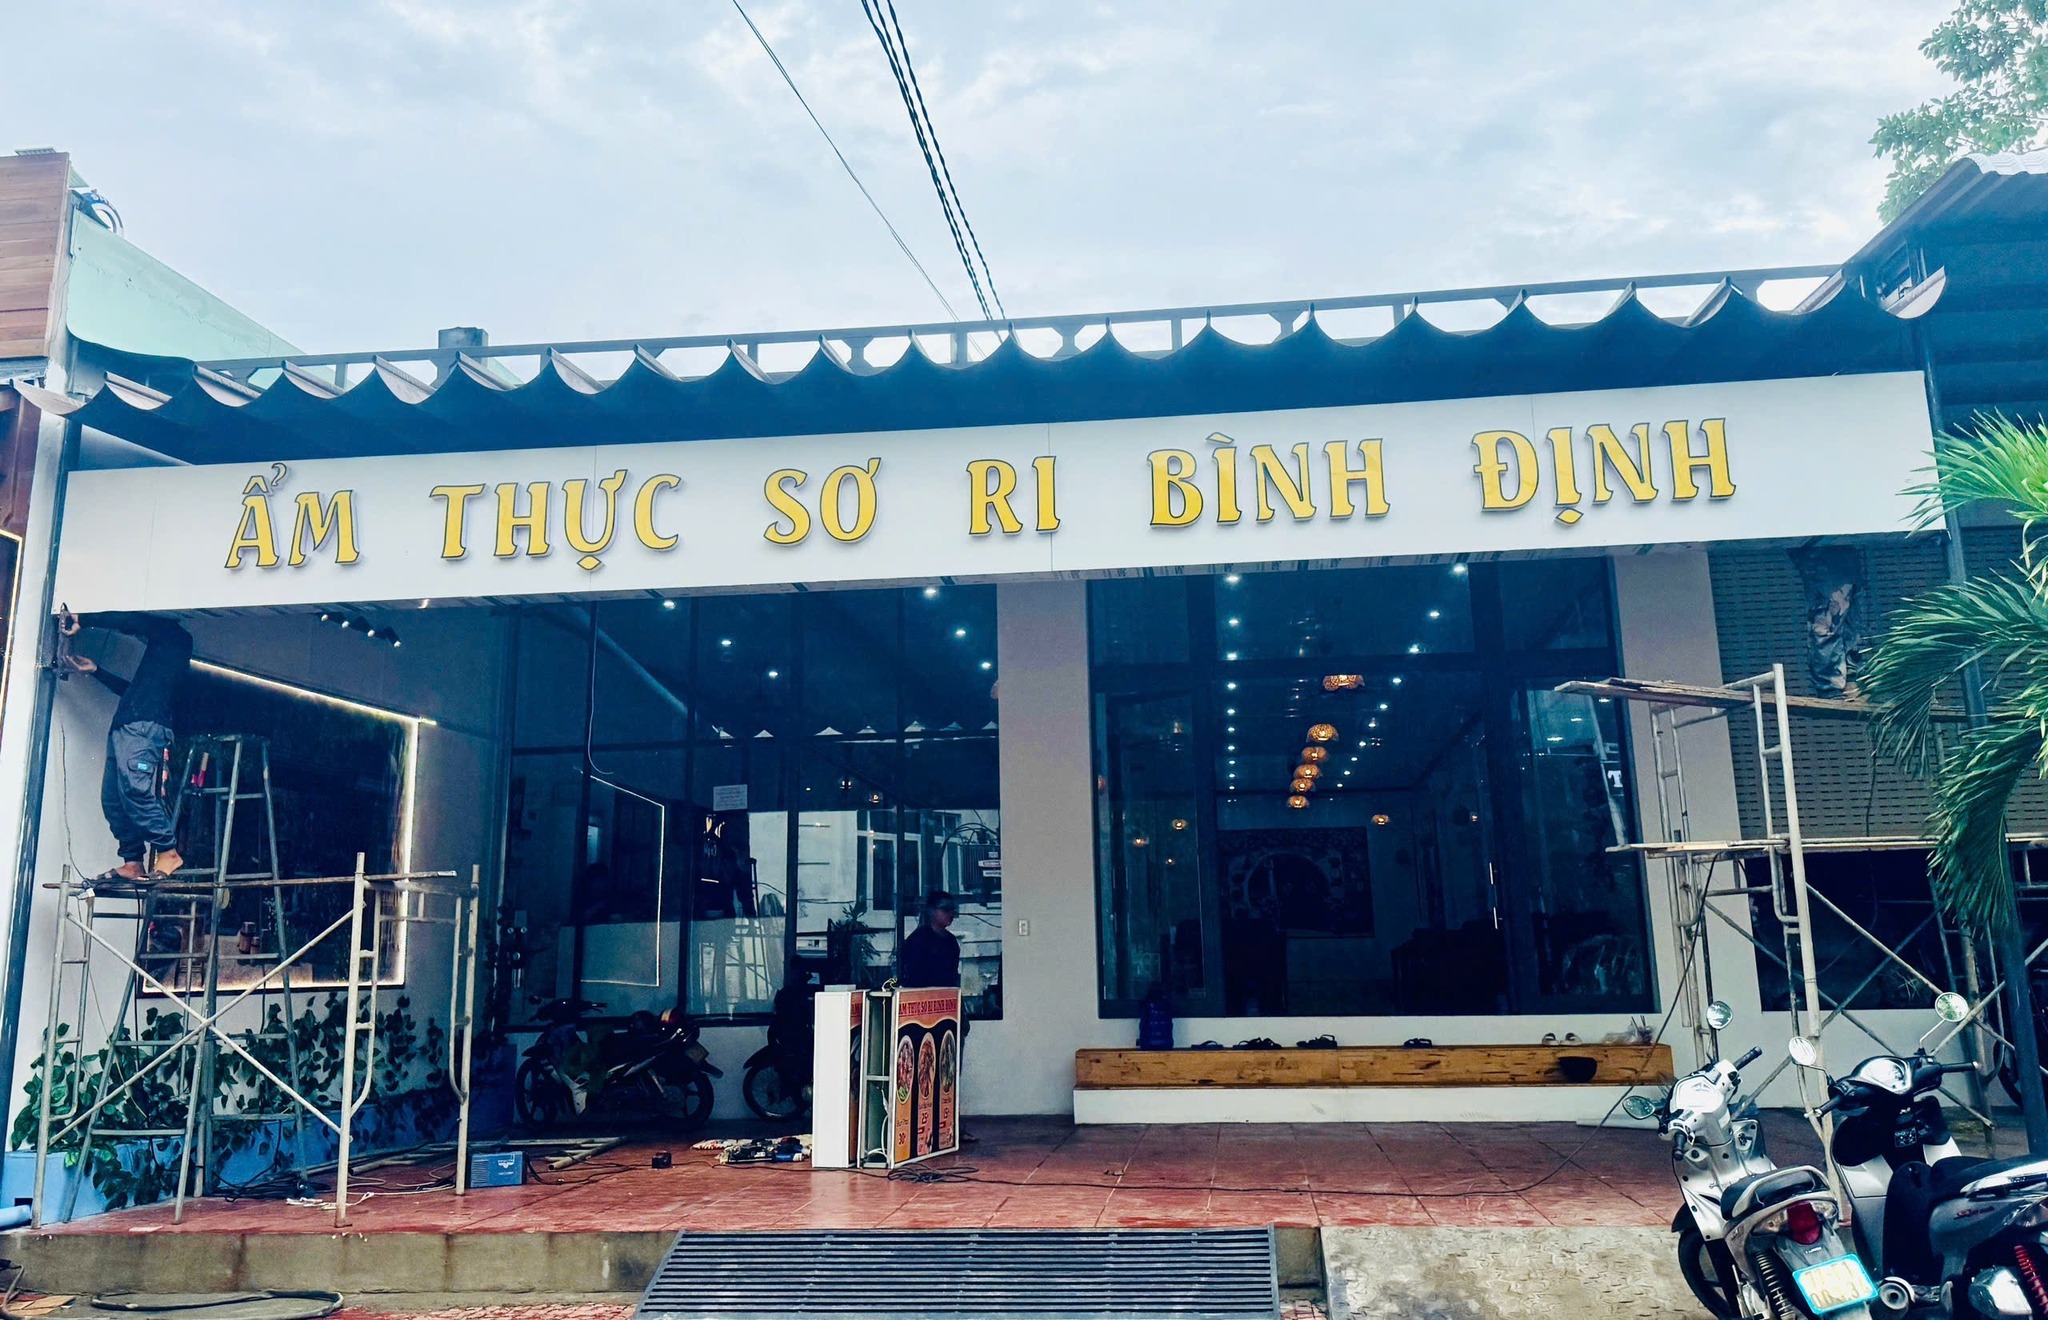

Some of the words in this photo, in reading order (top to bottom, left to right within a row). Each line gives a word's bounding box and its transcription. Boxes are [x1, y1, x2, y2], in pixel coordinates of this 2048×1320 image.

[224, 461, 361, 570] ẨM
[428, 468, 683, 571] THỰC
[763, 456, 882, 545] SƠ
[965, 455, 1062, 537] RI
[1146, 431, 1391, 529] BÌNH
[1470, 417, 1737, 526] ĐỊNH
